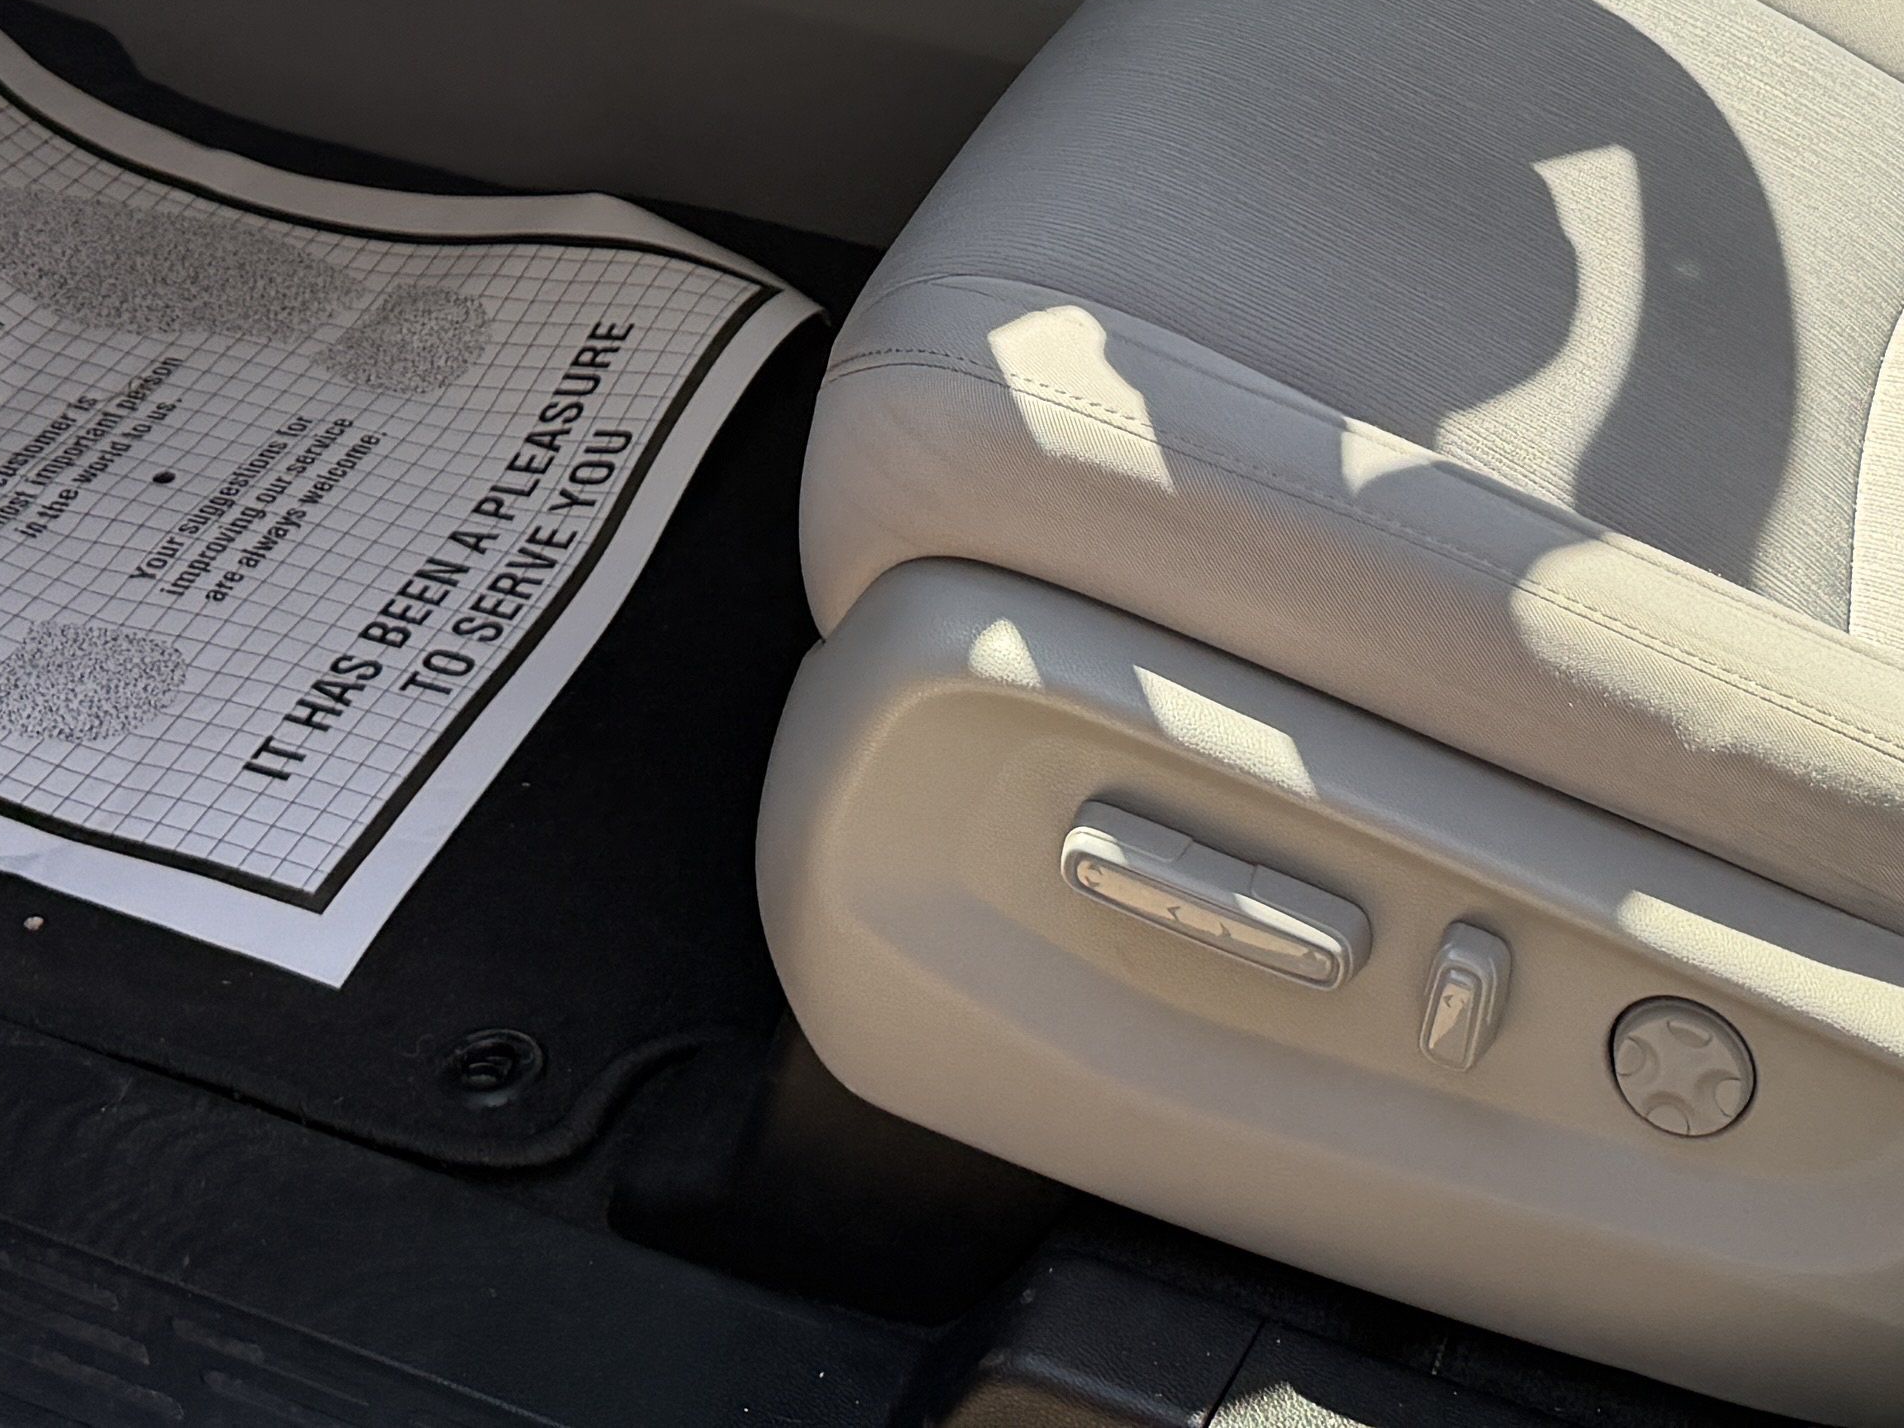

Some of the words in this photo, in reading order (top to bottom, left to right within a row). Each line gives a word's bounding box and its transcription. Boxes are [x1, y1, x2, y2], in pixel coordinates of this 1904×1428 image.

[15, 521, 46, 538] in
[38, 487, 79, 519] the
[72, 438, 132, 485] world
[122, 423, 152, 440] to
[147, 397, 183, 422] us.
[26, 410, 122, 486] important
[116, 355, 183, 412] person
[69, 395, 98, 412] is
[473, 321, 636, 522] PLEASURE
[130, 536, 186, 581] Your
[178, 439, 289, 535] suggestions
[276, 415, 314, 438] for
[159, 506, 267, 597] improving
[256, 475, 293, 505] our
[286, 417, 354, 476] service
[205, 571, 246, 603] are
[238, 506, 307, 569] always
[298, 431, 388, 506] welcome.
[400, 647, 477, 696] TO
[452, 525, 578, 643] SERVE
[549, 428, 634, 514] YOU
[448, 529, 500, 555] A
[358, 556, 471, 649] BEEN
[243, 735, 306, 782] IT
[283, 654, 383, 733] HAS
